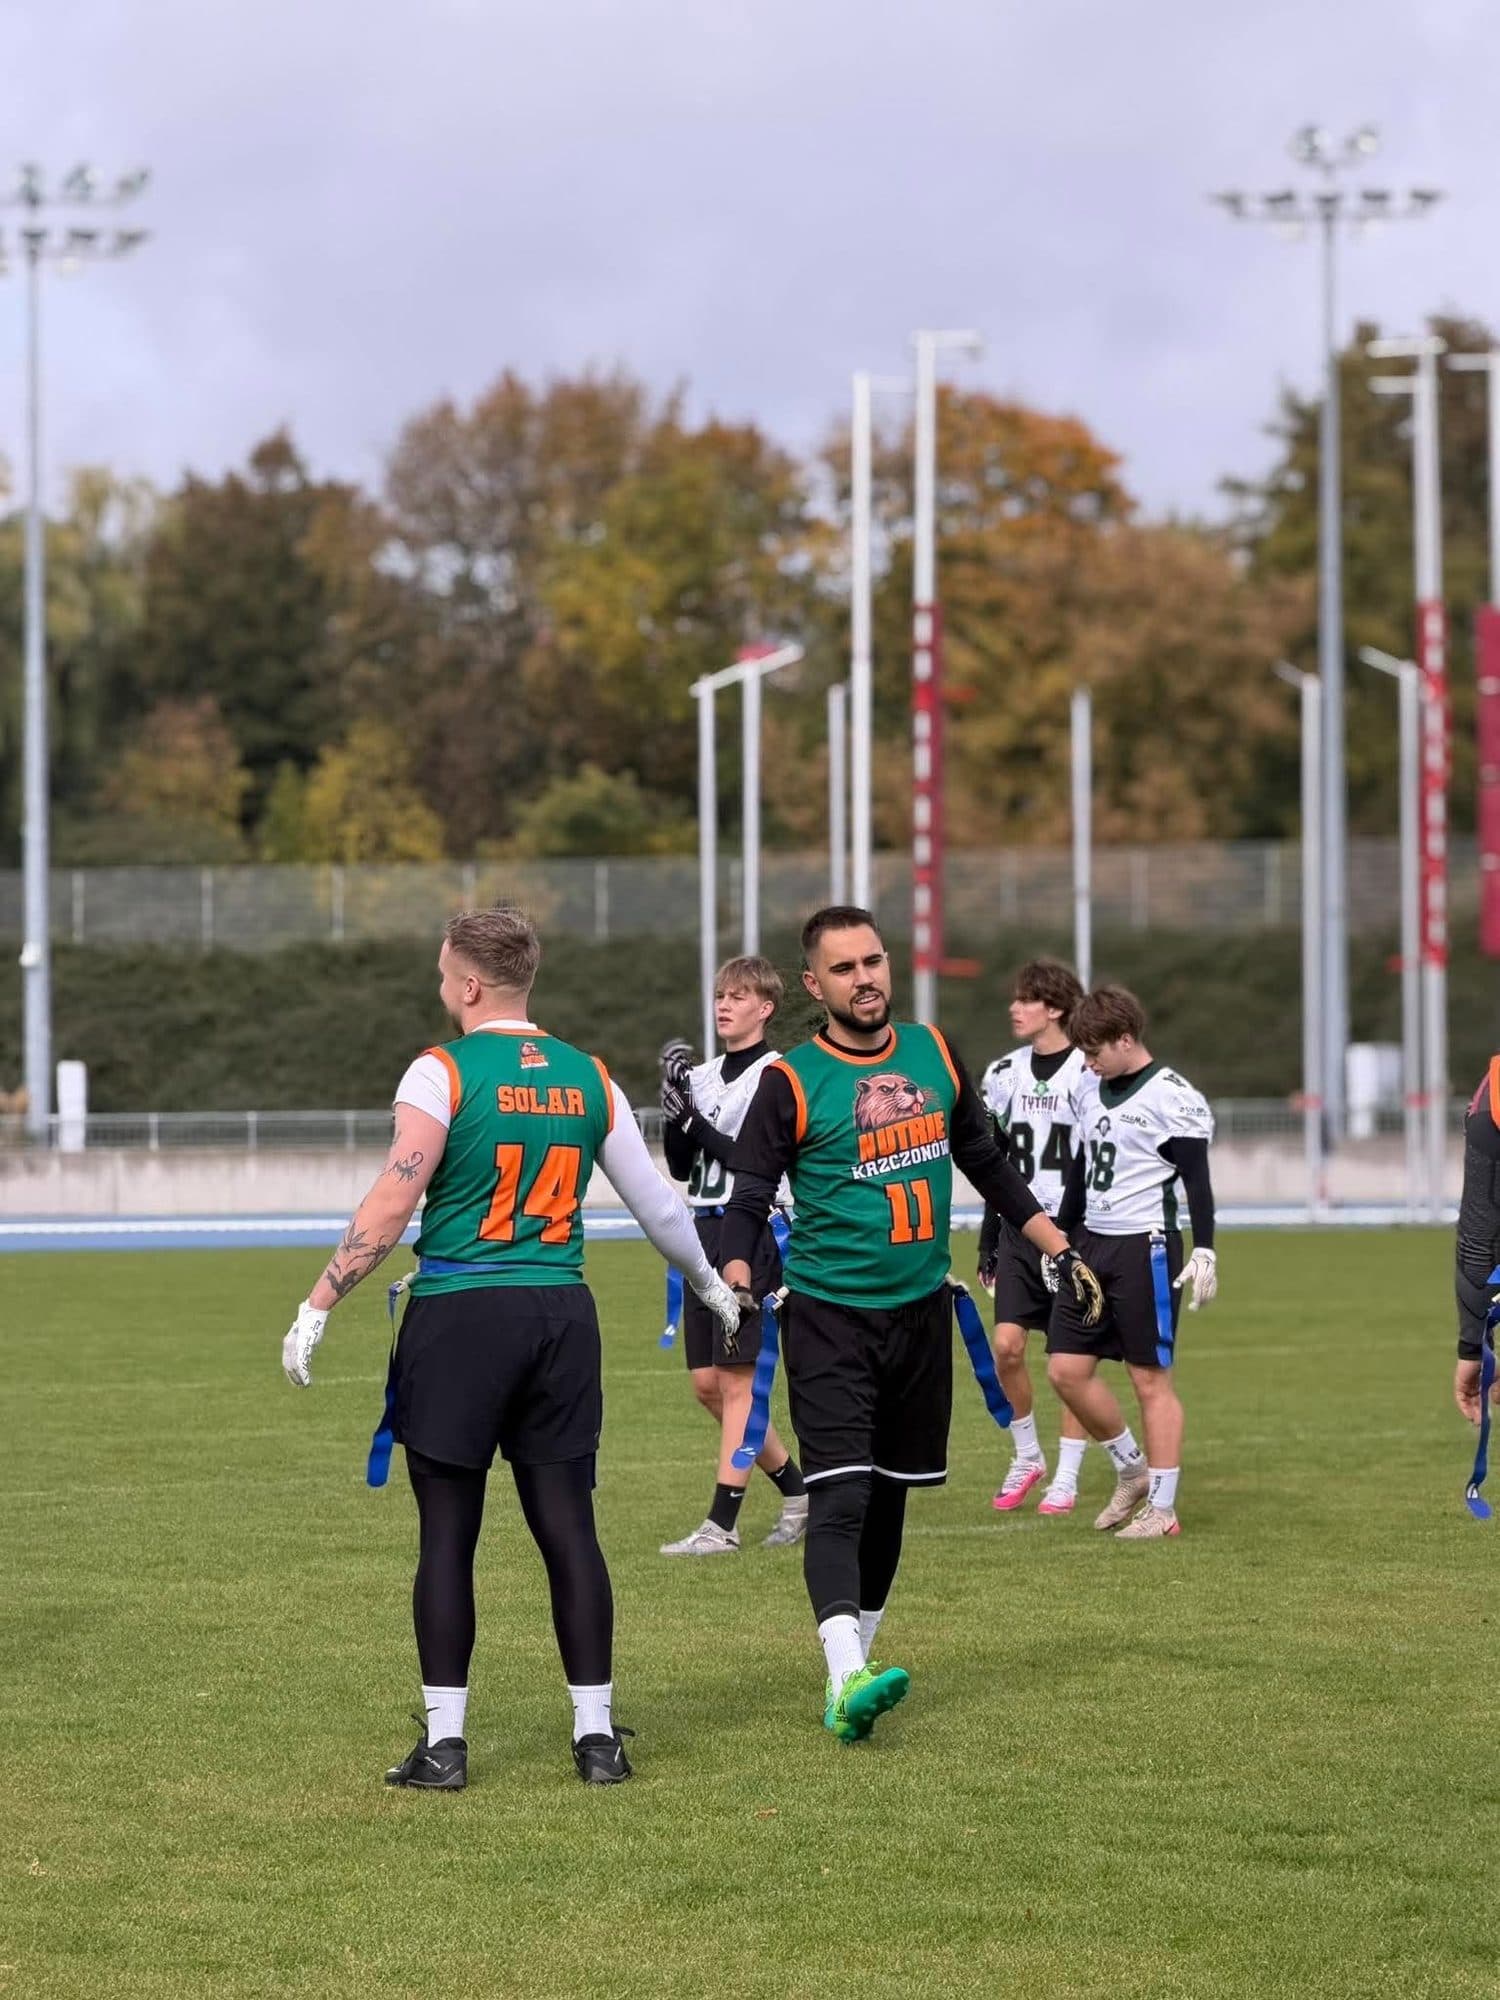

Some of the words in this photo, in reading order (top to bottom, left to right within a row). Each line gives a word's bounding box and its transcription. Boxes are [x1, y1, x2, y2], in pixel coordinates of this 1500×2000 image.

[496, 1084, 586, 1116] SOLAR
[851, 1138, 950, 1180] KRZCZONÓW
[858, 1110, 946, 1163] NUTRIE
[1008, 1122, 1073, 1186] 84
[476, 1142, 582, 1244] 14
[884, 1177, 935, 1245] 11
